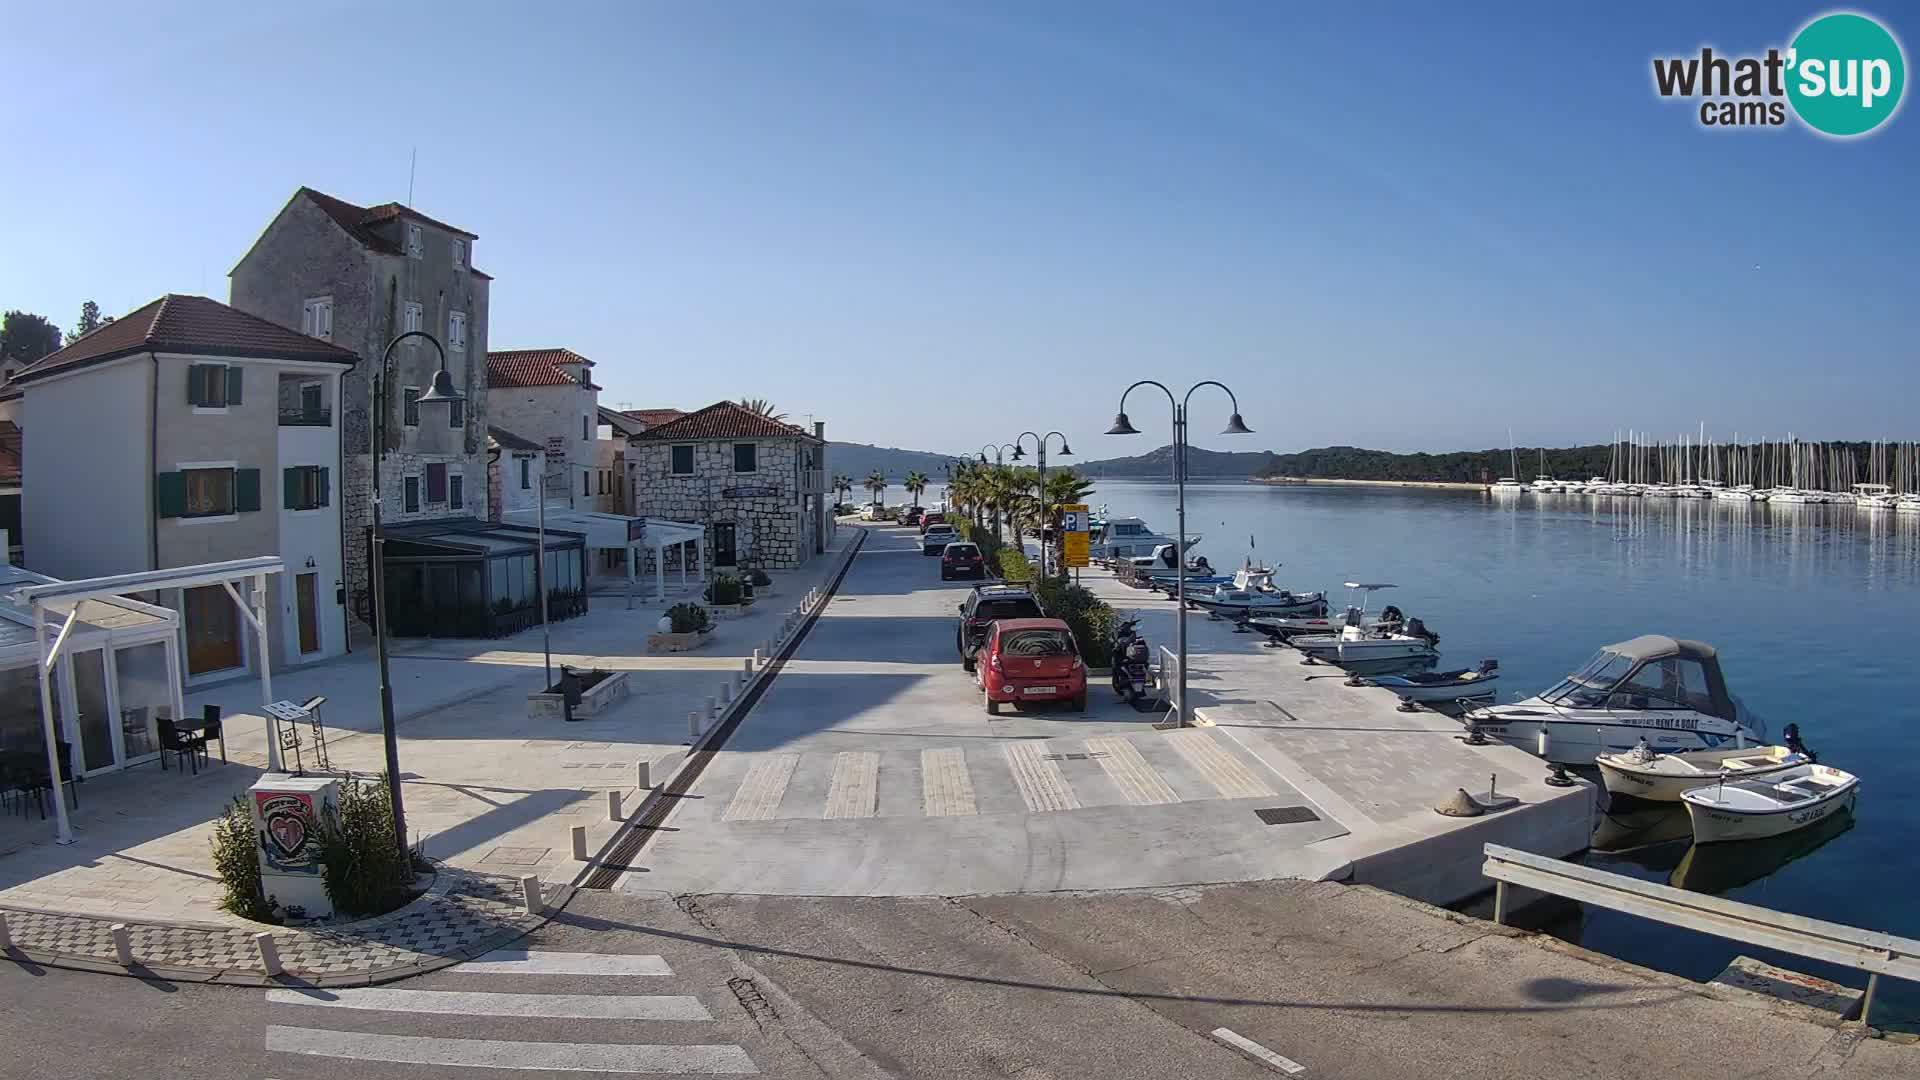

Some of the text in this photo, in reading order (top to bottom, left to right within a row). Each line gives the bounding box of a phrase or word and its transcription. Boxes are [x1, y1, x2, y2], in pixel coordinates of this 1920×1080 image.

[1066, 514, 1076, 530] P
[1656, 719, 1673, 728] RENT
[1681, 719, 1699, 729] BOAT
